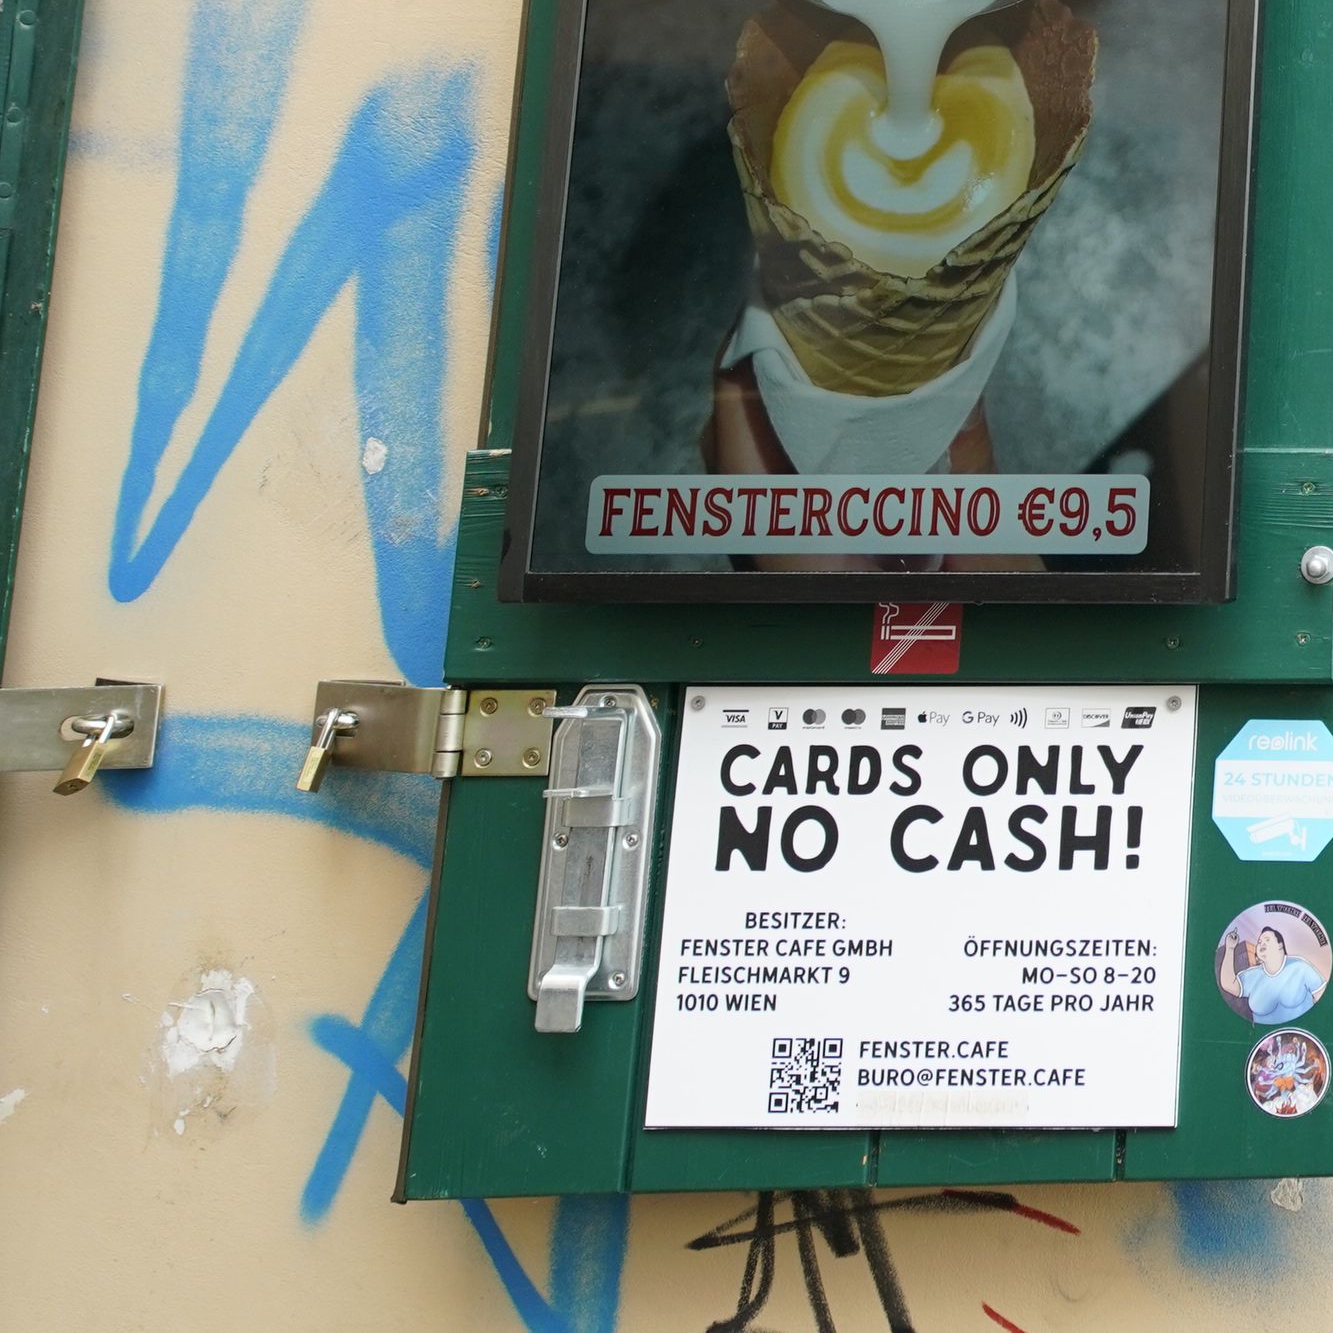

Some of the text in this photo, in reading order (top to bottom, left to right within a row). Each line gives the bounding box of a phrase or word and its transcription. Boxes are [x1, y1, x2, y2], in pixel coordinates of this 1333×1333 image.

[598, 486, 1137, 543] FENSTERCCINO €9,5
[724, 713, 747, 724] VISA
[929, 711, 951, 727] Pay
[977, 711, 1001, 728] Pay
[1248, 731, 1319, 753] reolink
[719, 743, 1145, 797] CARDS ONLY
[1223, 772, 1248, 787] 24
[714, 804, 1144, 874] NO CASH!
[744, 912, 847, 930] BESITZER:
[680, 939, 894, 958] FENSTER CAFE GMBH
[963, 935, 1158, 958] ÖFFNUNGSZEITEN:
[678, 966, 851, 985] FLEISCHMARKT 9
[676, 994, 778, 1013] 1010 WIEN
[948, 994, 1155, 1013] 365 TAGE PRO JAHR
[858, 1040, 1010, 1060] FENSTER.CAFE
[857, 1068, 1086, 1088] BURO@FENSTER.CAFE
